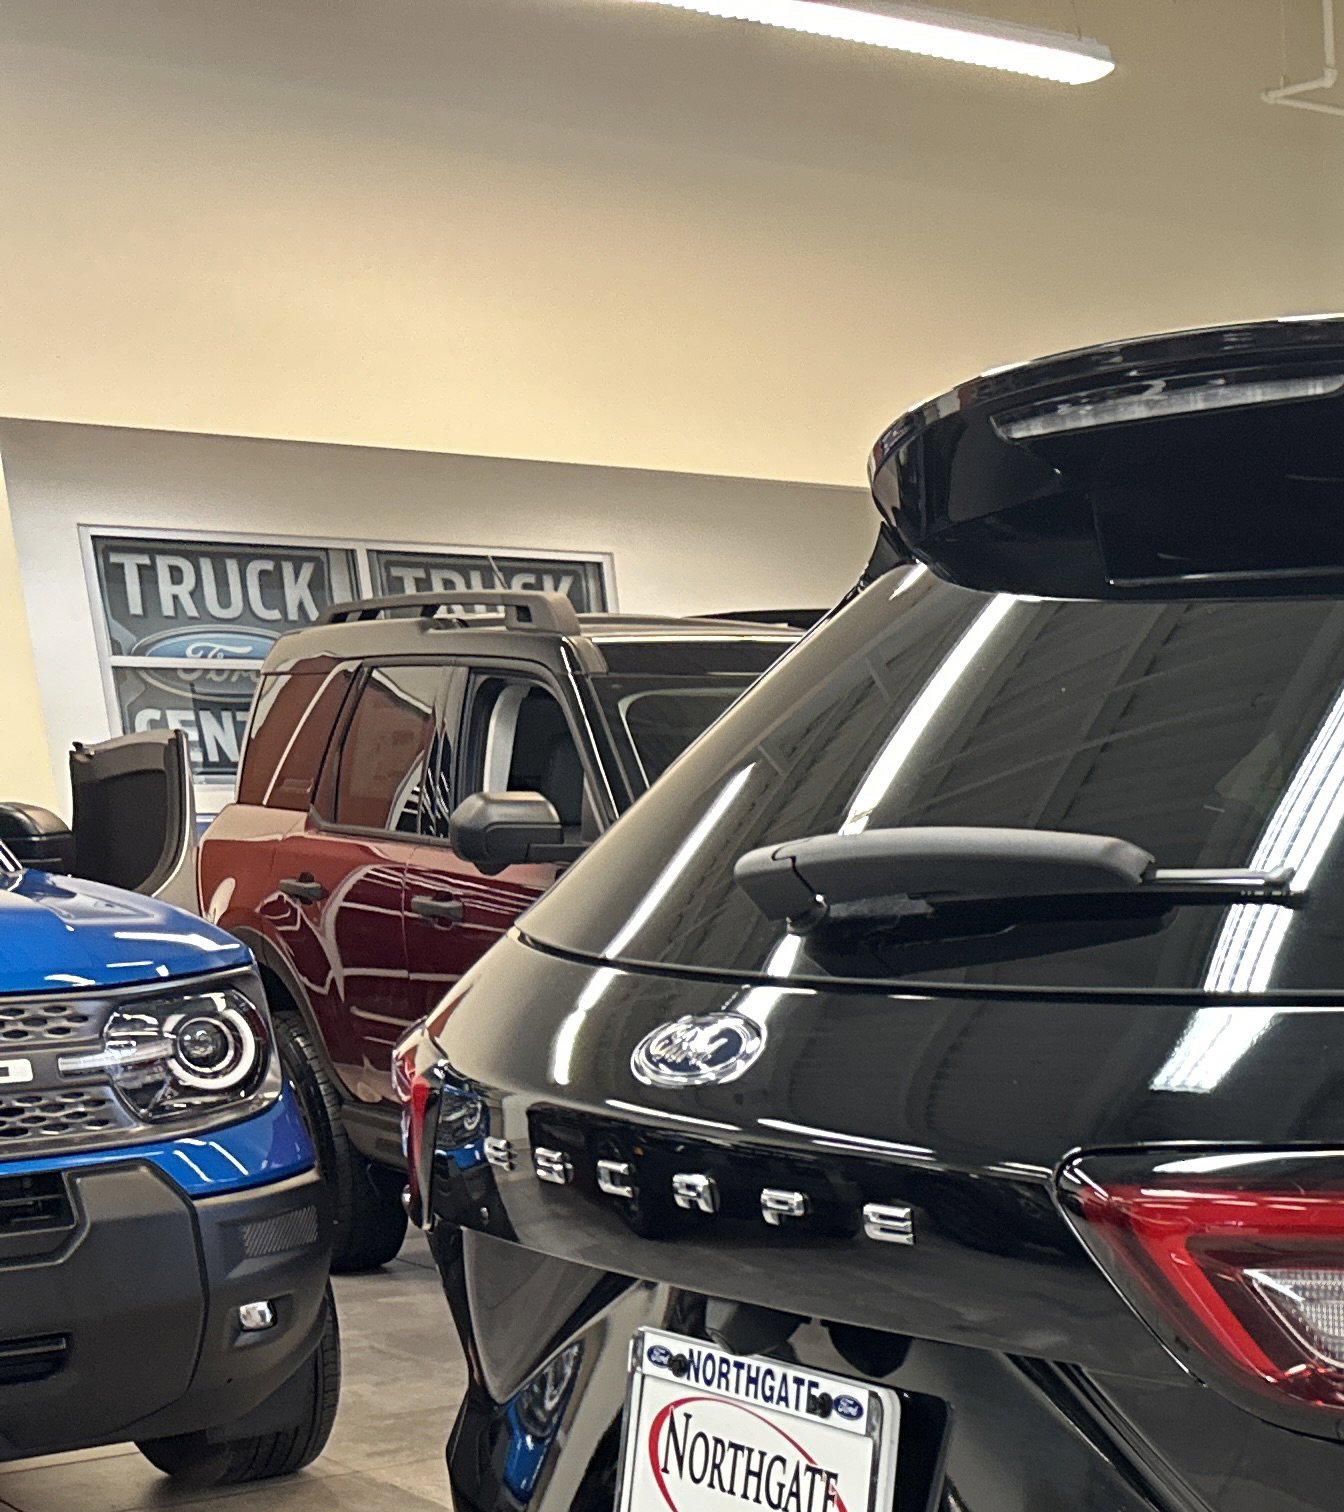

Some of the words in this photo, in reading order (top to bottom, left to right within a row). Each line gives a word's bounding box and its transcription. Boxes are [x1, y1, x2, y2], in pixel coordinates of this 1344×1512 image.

[109, 552, 319, 622] TRUCK
[176, 642, 261, 683] For
[484, 1136, 915, 1245] ESCAPE
